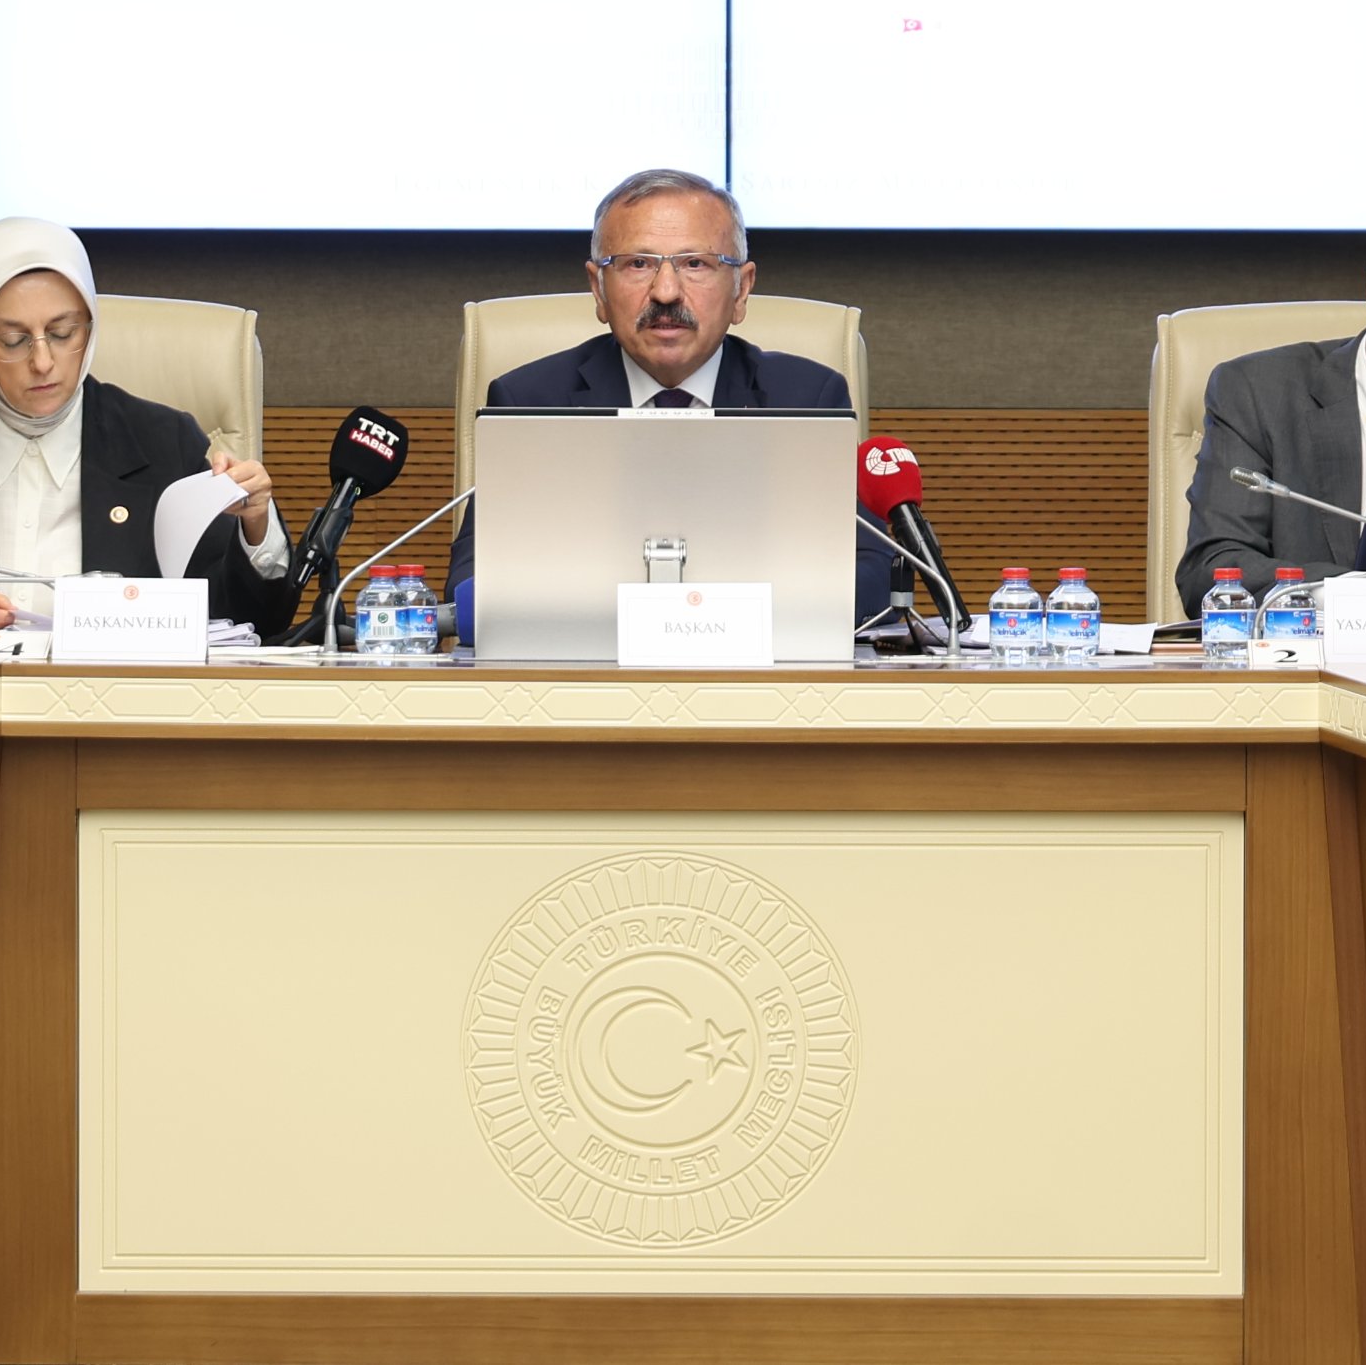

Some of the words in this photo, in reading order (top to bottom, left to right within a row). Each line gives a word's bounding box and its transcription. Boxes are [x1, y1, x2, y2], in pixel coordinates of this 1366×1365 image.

[351, 430, 394, 460] HABER
[358, 417, 400, 447] TRT
[73, 615, 187, 631] BAŞKANVEKİLİ
[664, 621, 726, 636] BAŞKAN
[1274, 649, 1299, 663] 2
[562, 915, 762, 979] TÜRKİYE
[525, 985, 578, 1131] BÜYÜK
[578, 1134, 721, 1187] MİLLET
